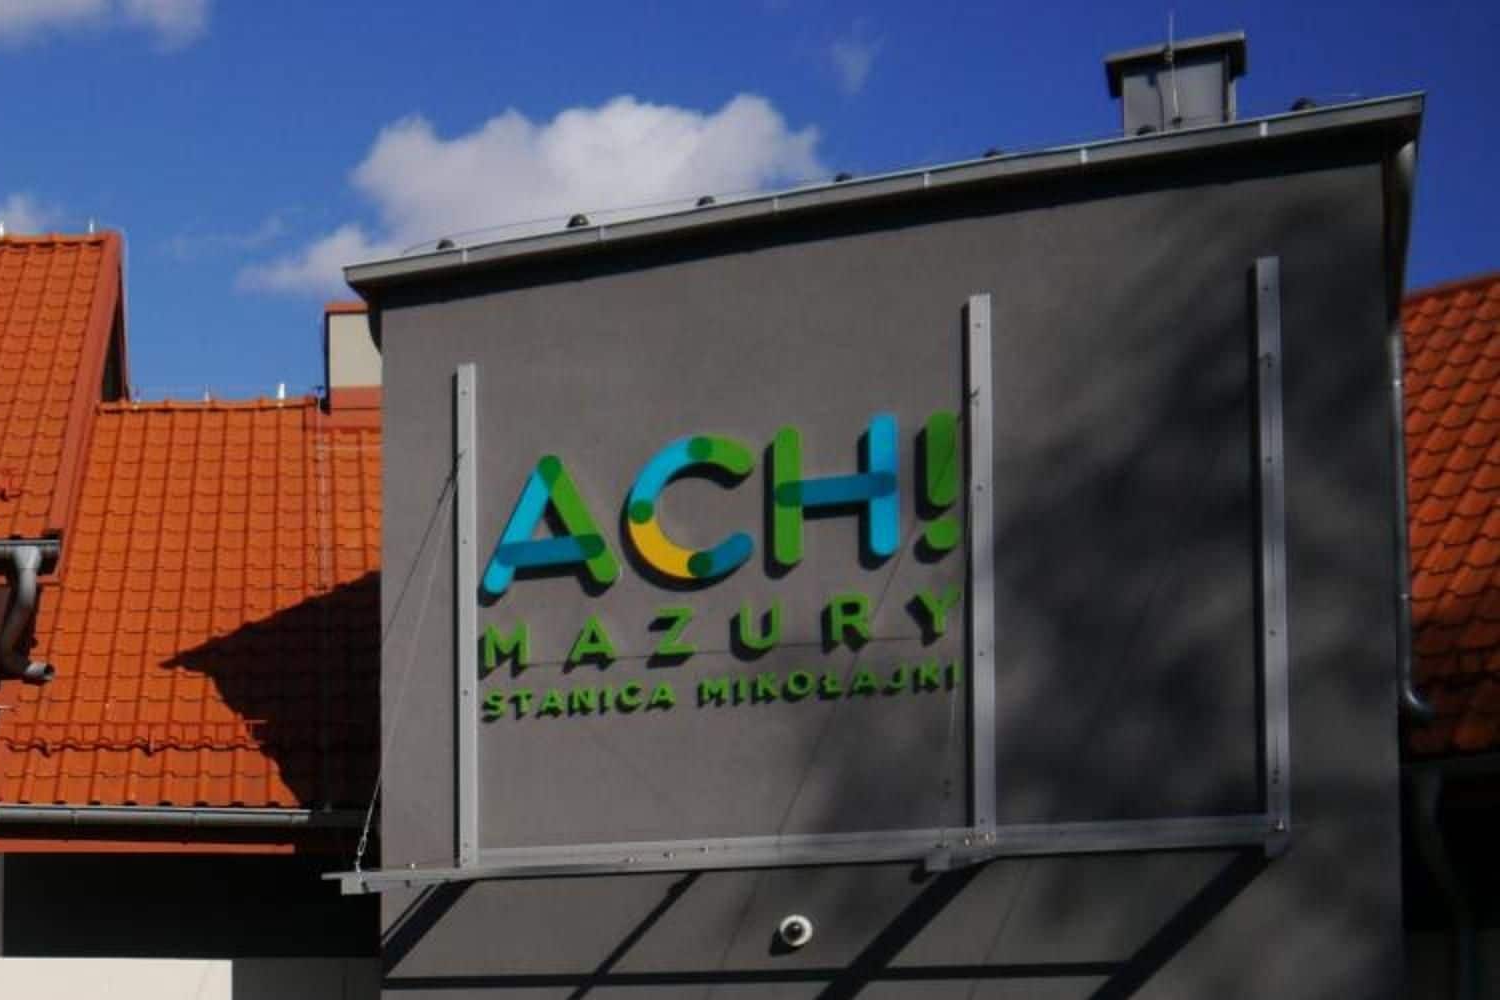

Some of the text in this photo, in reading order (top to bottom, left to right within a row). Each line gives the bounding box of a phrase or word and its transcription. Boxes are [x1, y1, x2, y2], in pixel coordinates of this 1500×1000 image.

[482, 409, 960, 597] ACH!
[482, 586, 961, 670] MAZURY
[482, 680, 677, 719] STANICA
